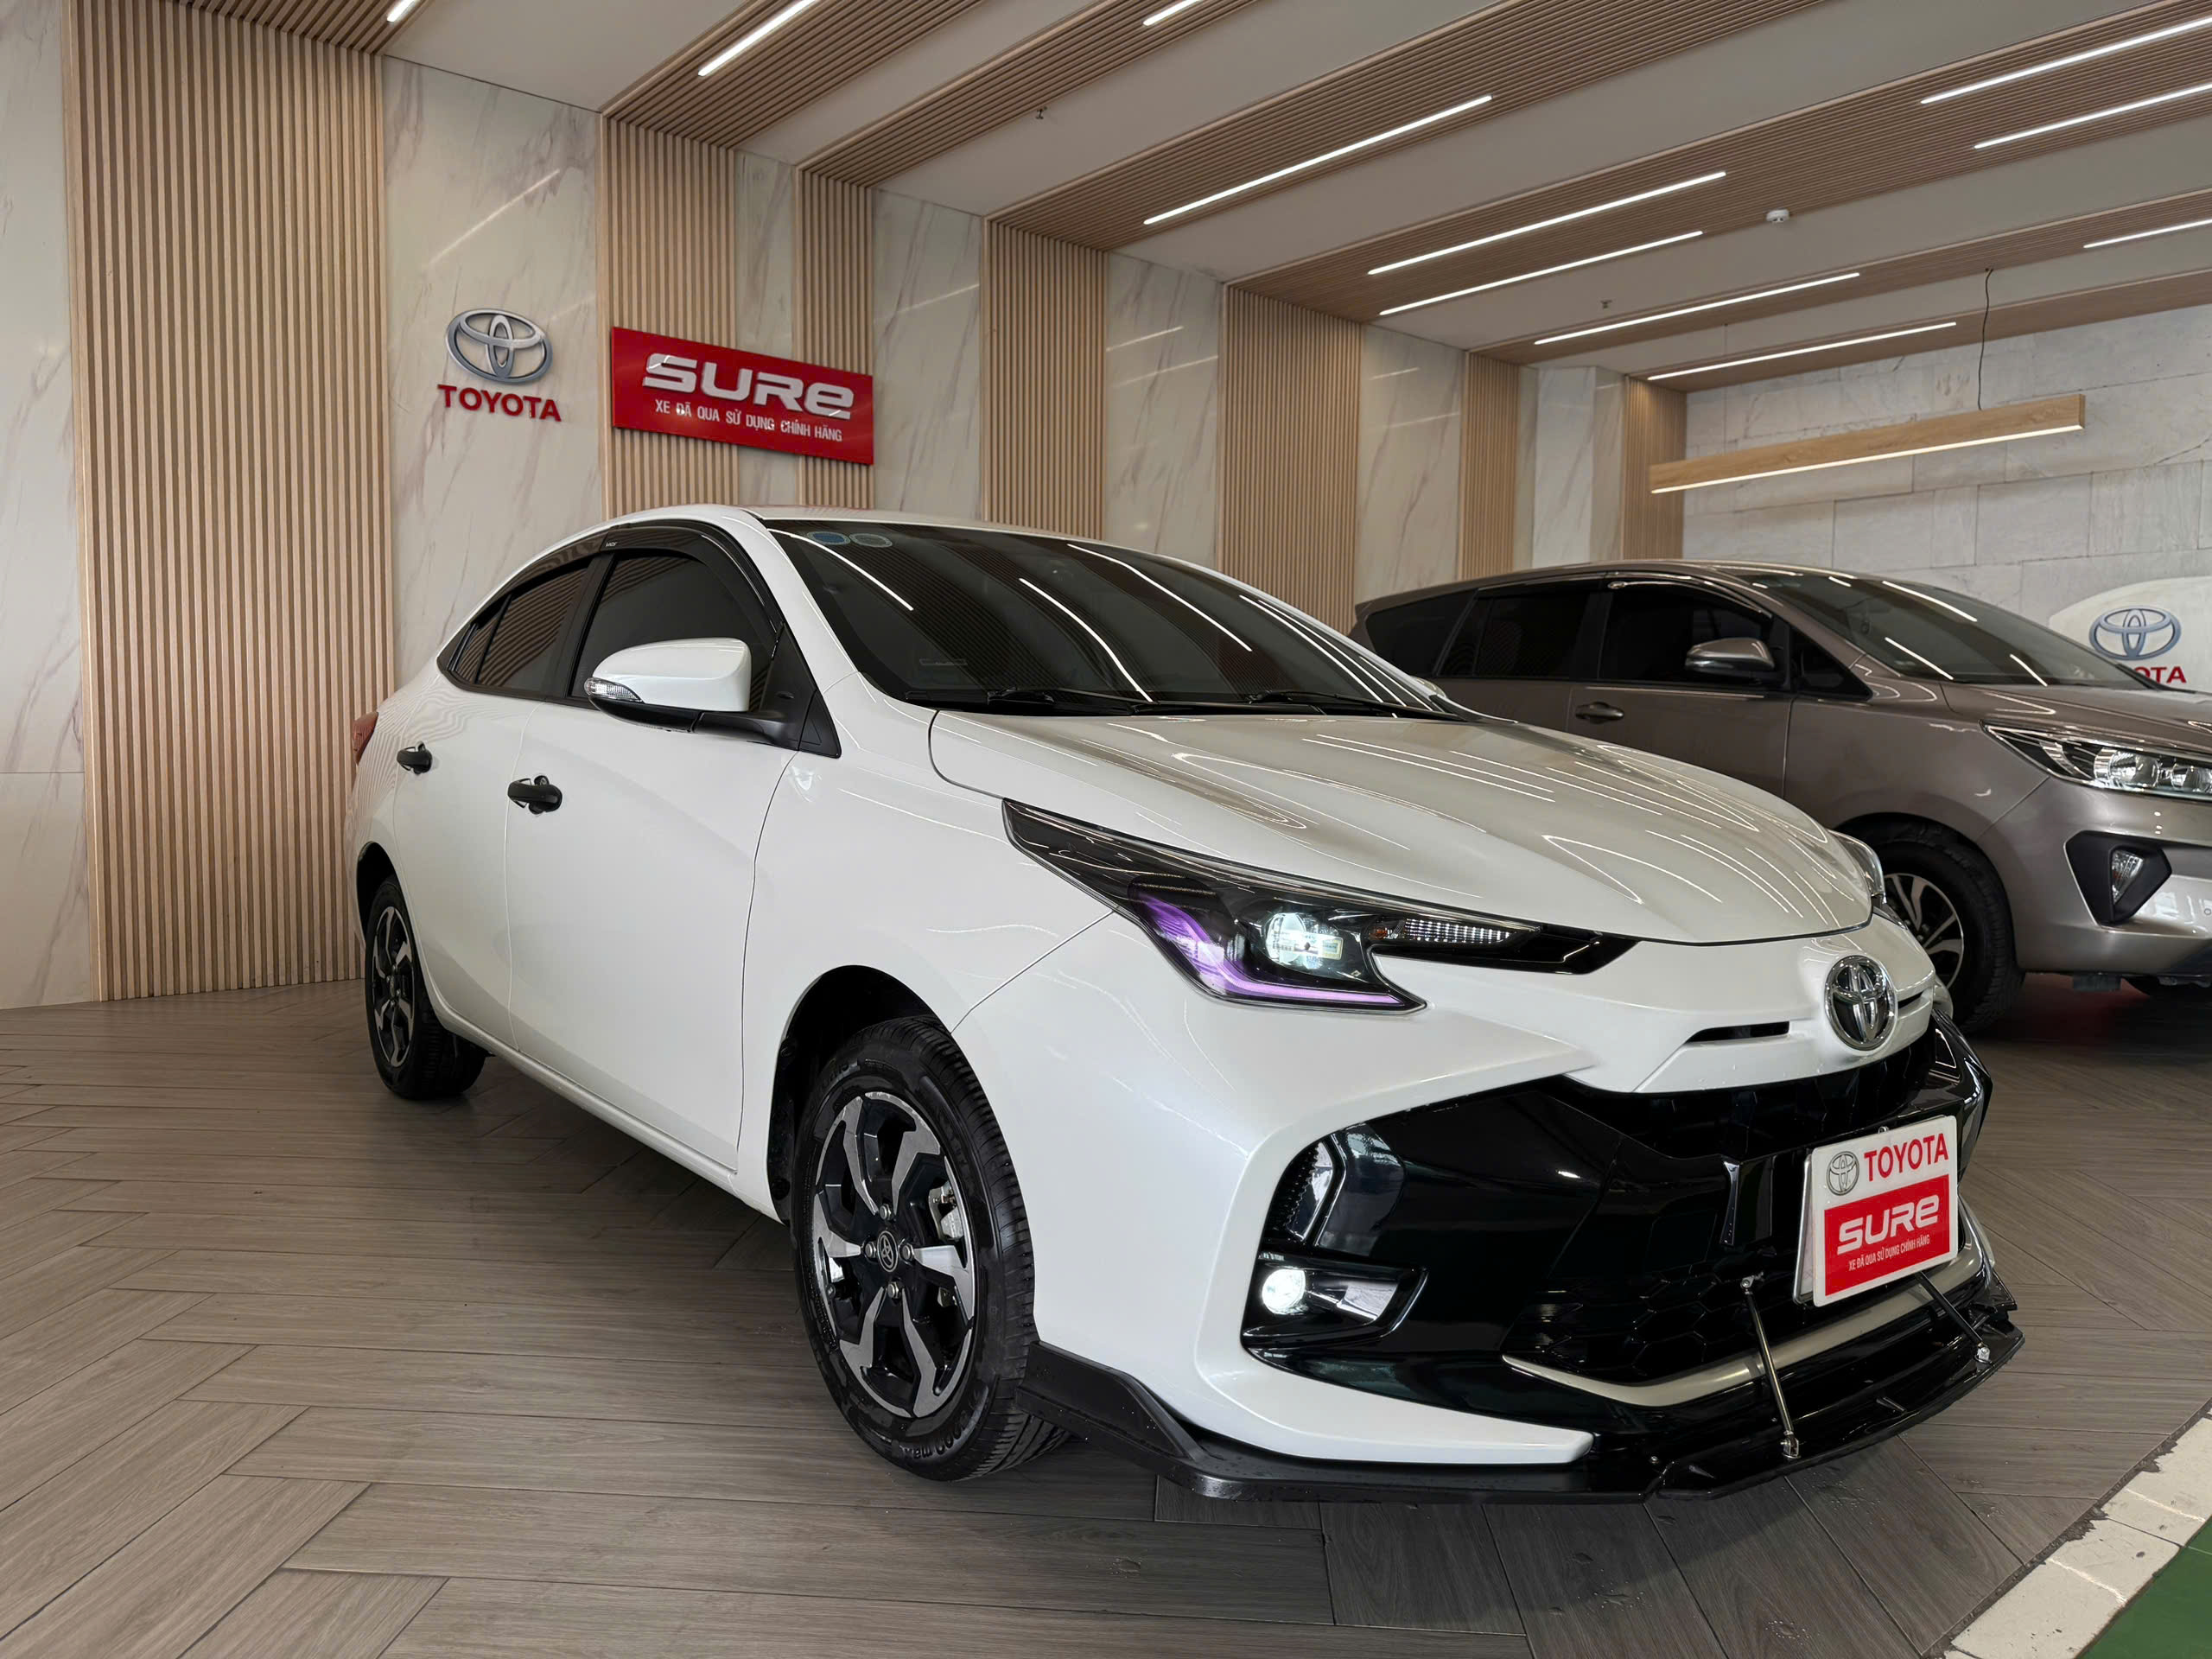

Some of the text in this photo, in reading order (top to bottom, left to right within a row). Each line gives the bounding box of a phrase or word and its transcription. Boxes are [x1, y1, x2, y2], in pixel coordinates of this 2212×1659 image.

[438, 385, 561, 422] TOYOTA
[655, 399, 842, 442] XE ĐÃ QUA SỬ DỤNG CHÍNH HÃNG
[1864, 1133, 1949, 1182] TOYOTA
[1848, 1259, 1857, 1272] XE
[1866, 1252, 1876, 1266] QUA
